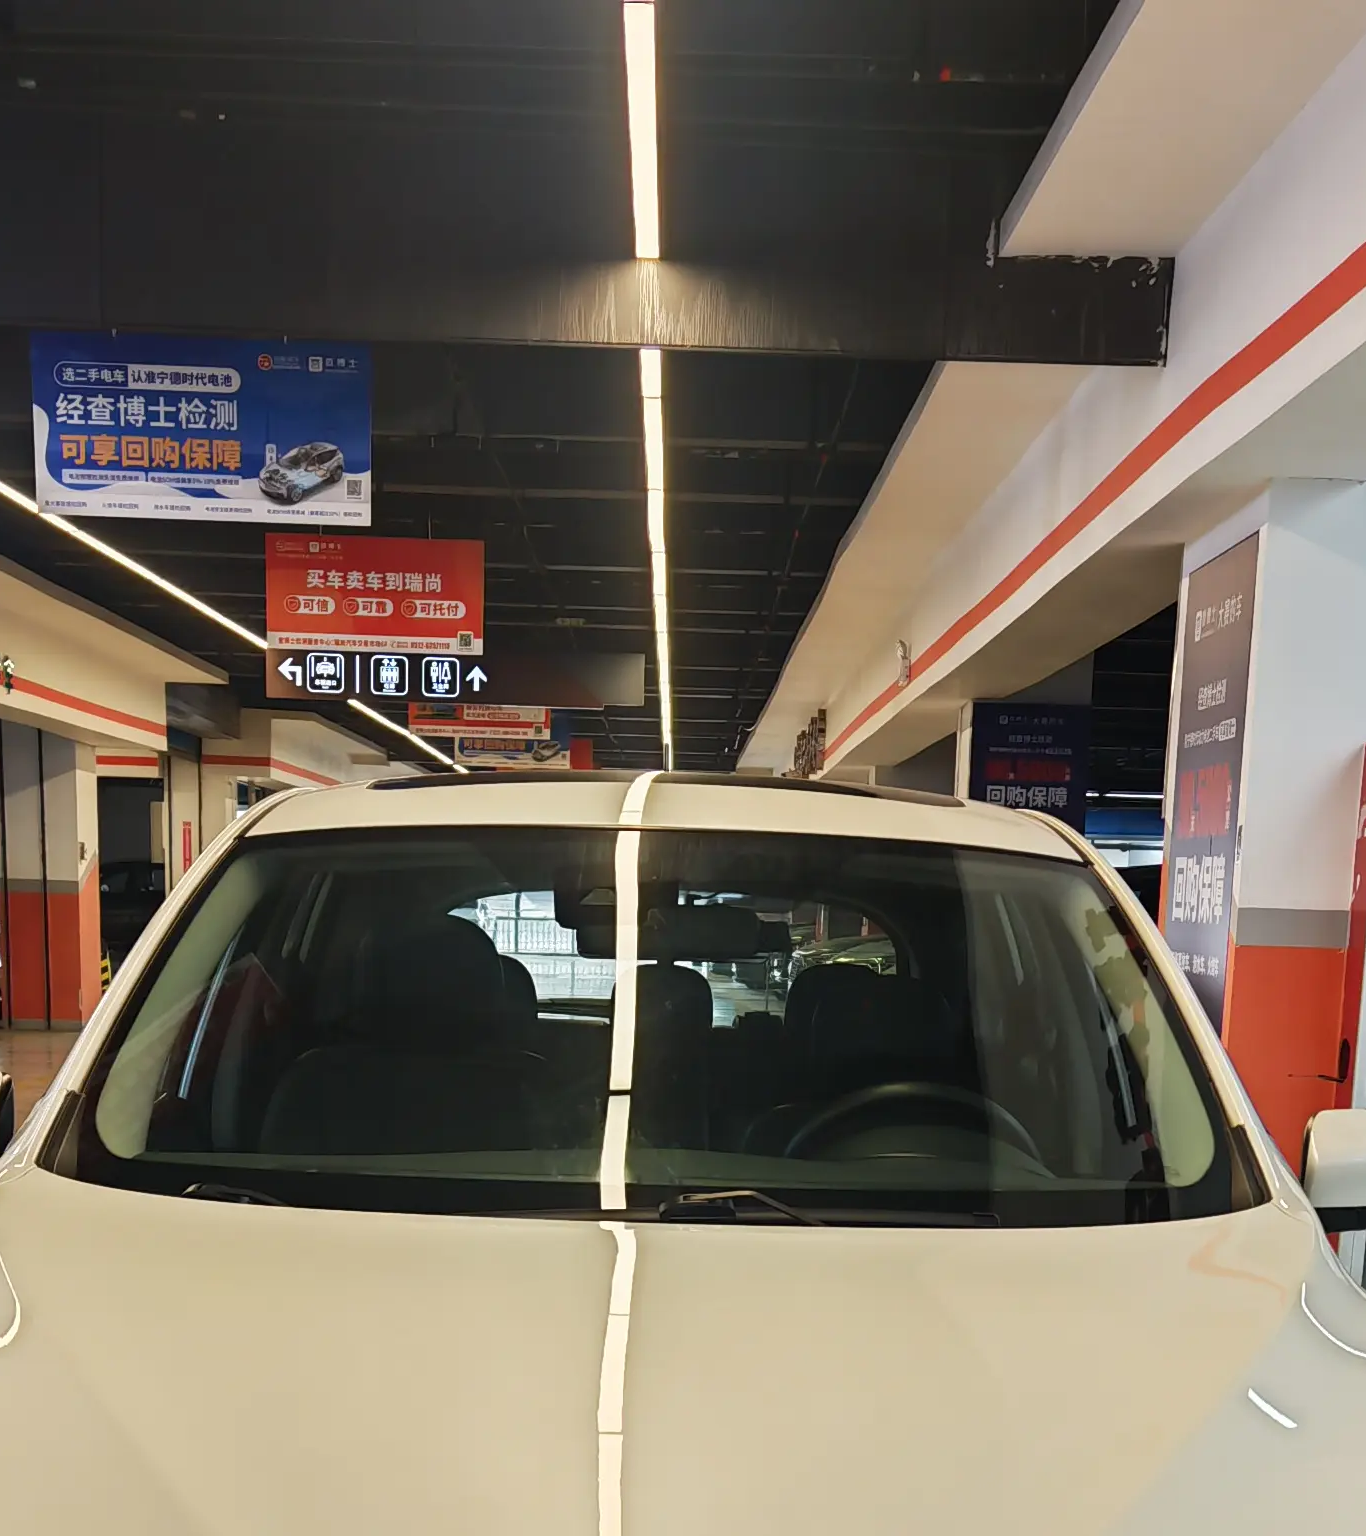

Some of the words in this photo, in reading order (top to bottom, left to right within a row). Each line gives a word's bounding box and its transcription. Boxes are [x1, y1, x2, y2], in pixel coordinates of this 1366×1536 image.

[62, 367, 126, 384] 选二手电车
[131, 370, 233, 388] 认准宁德时代电池
[55, 392, 238, 431] 经查博士检测
[59, 433, 242, 472] 可享回购保障
[306, 569, 442, 593] 买车卖车到瑞尚
[302, 598, 329, 613] 可信
[419, 602, 460, 617] 可托付
[986, 784, 1068, 808] 回购保障
[1171, 853, 1226, 925] 回购保障
